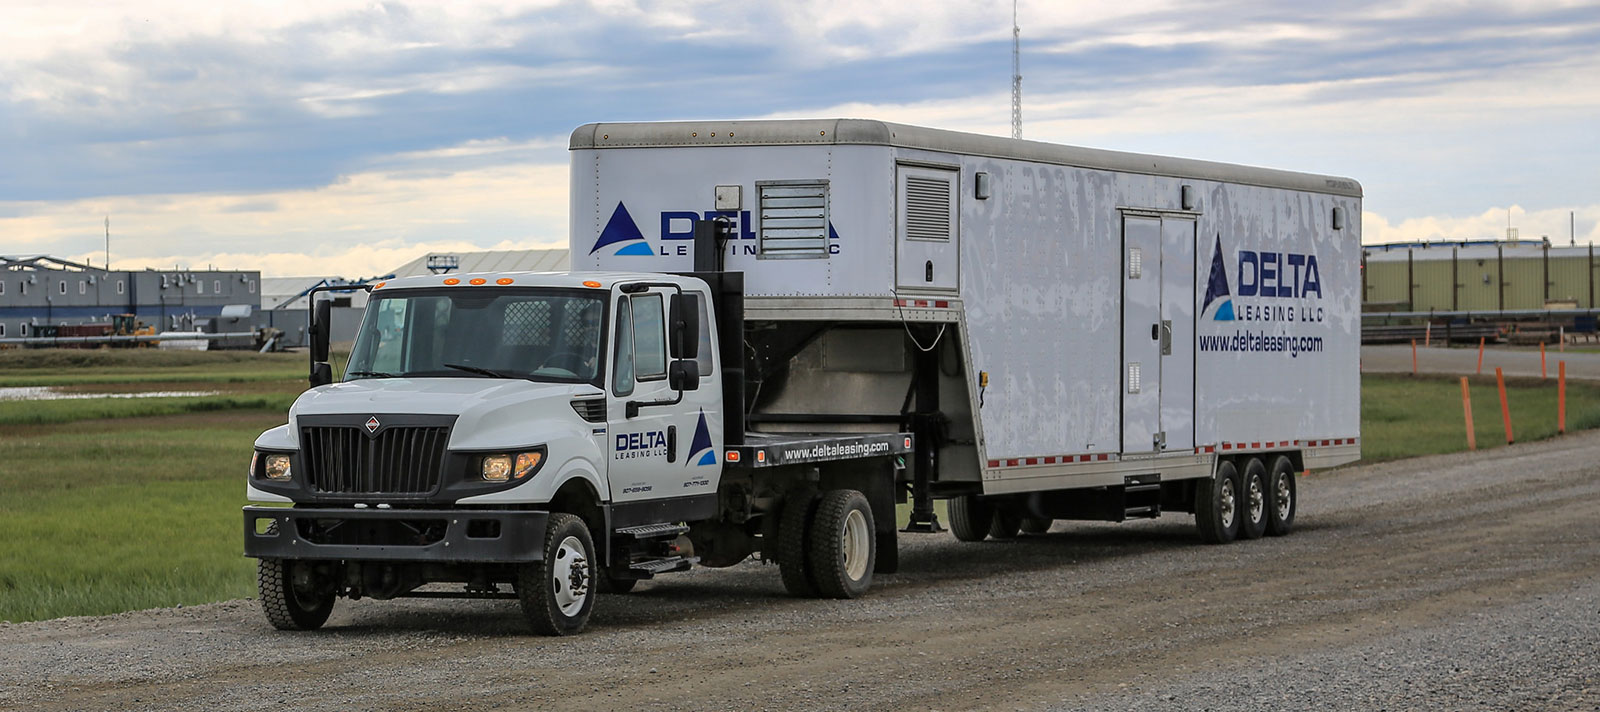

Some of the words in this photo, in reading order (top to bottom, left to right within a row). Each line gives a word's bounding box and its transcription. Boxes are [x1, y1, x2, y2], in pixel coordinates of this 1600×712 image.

[660, 210, 840, 240] DEL
[1238, 250, 1322, 299] DELTA
[1238, 305, 1294, 322] LEASING
[1301, 308, 1323, 322] LLC
[1199, 330, 1323, 358] www.deltaleasing.com
[616, 430, 667, 451] DELTA
[785, 441, 889, 460] www.deltaleasing.com
[615, 450, 650, 460] LEASING
[654, 449, 668, 457] LLC
